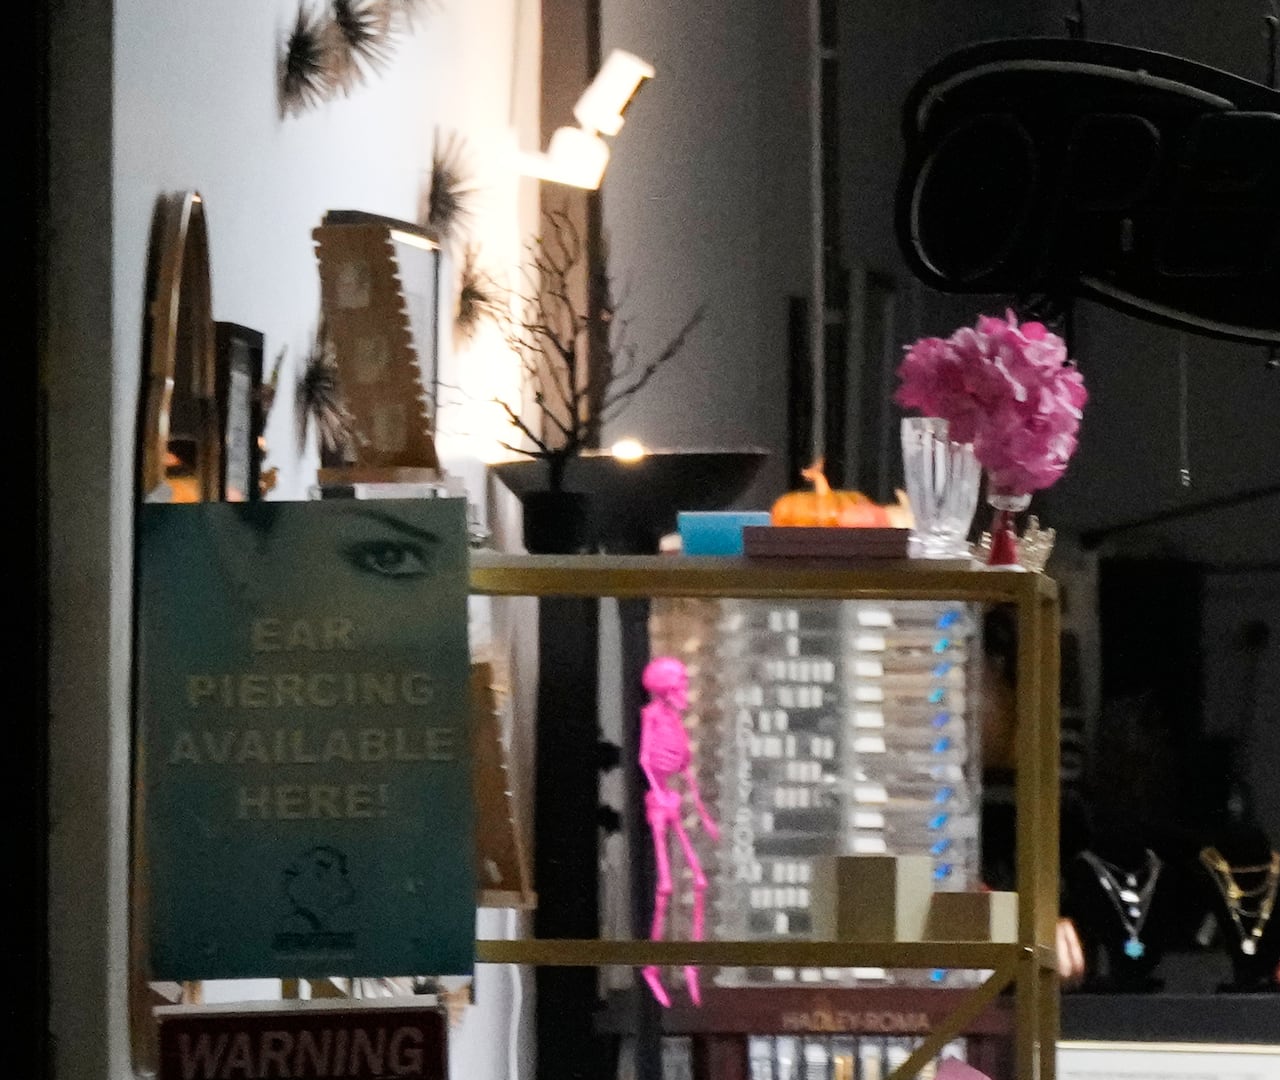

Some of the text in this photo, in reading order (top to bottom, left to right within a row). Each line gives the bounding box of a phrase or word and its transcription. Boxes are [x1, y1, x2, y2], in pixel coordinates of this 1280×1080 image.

[252, 617, 356, 652] EAR
[185, 671, 434, 709] PIERCING
[170, 726, 456, 765] AVAILABLE
[237, 783, 391, 821] HERE!
[176, 1026, 426, 1080] WARNING
